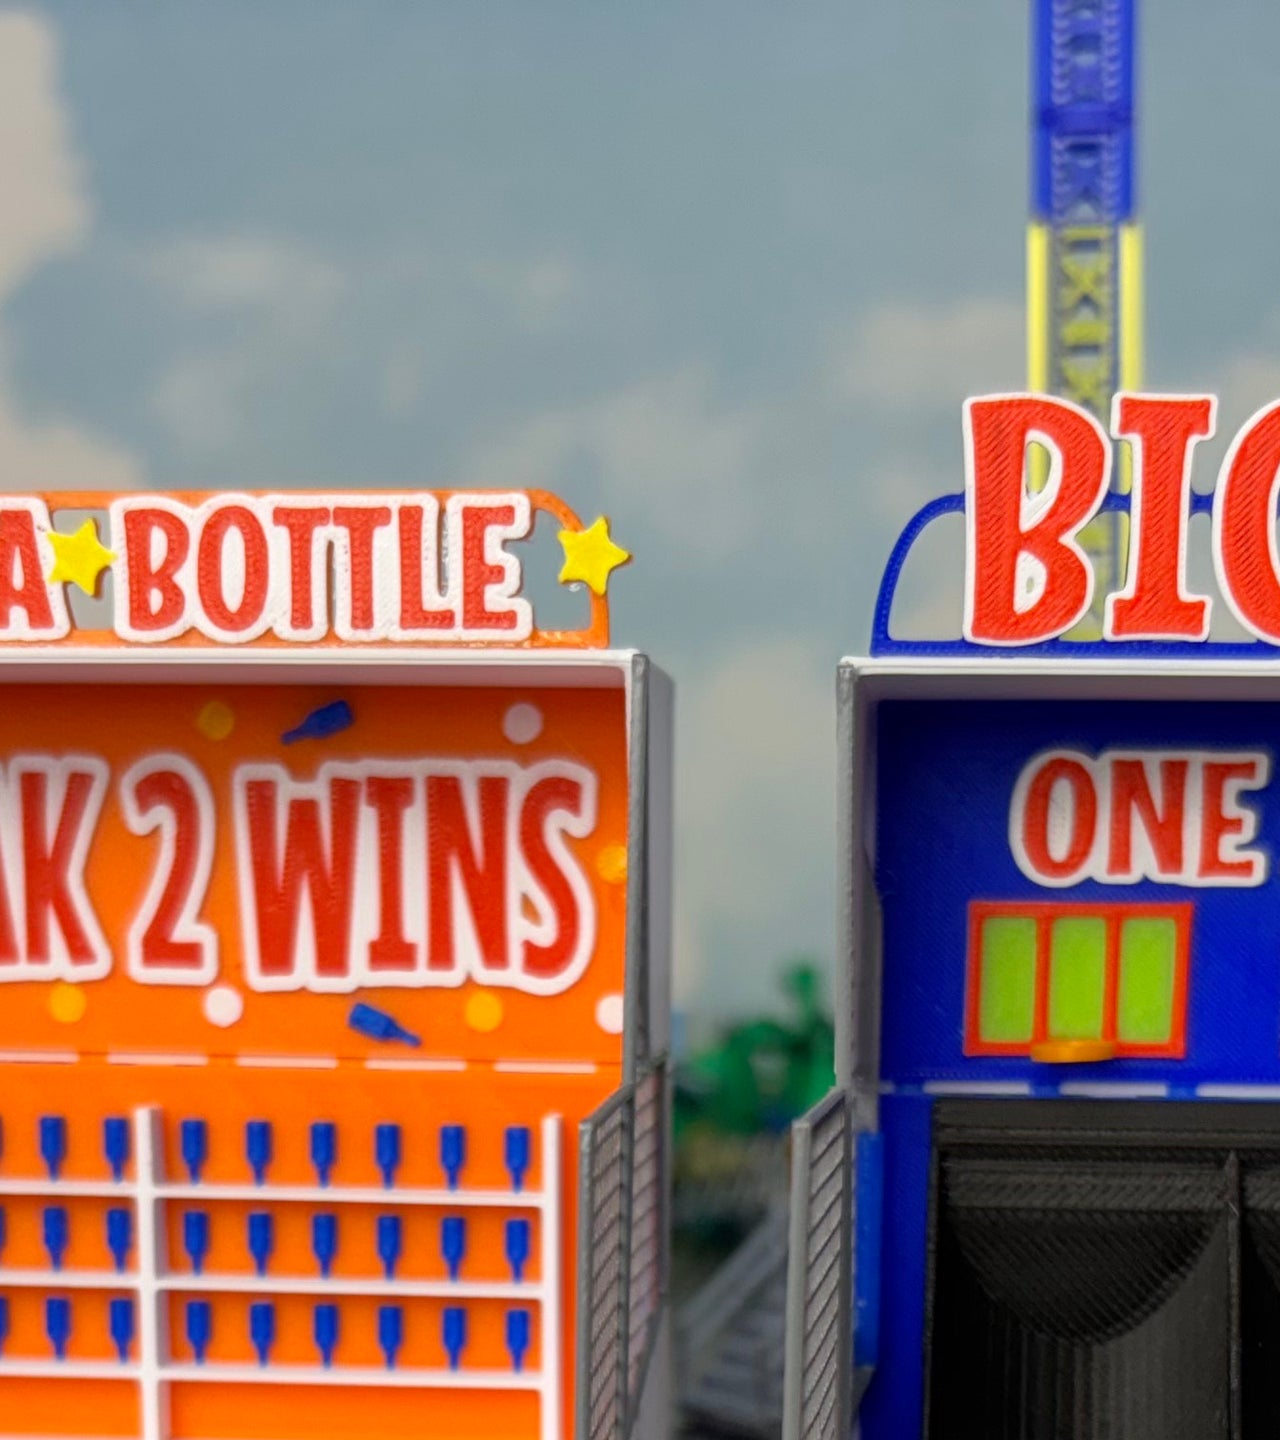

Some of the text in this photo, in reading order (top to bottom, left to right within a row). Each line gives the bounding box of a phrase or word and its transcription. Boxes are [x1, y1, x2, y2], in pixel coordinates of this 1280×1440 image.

[121, 502, 520, 633] BOTTLE
[129, 765, 218, 972] 2
[241, 772, 585, 980] WINS
[1020, 756, 1259, 881] ONE
